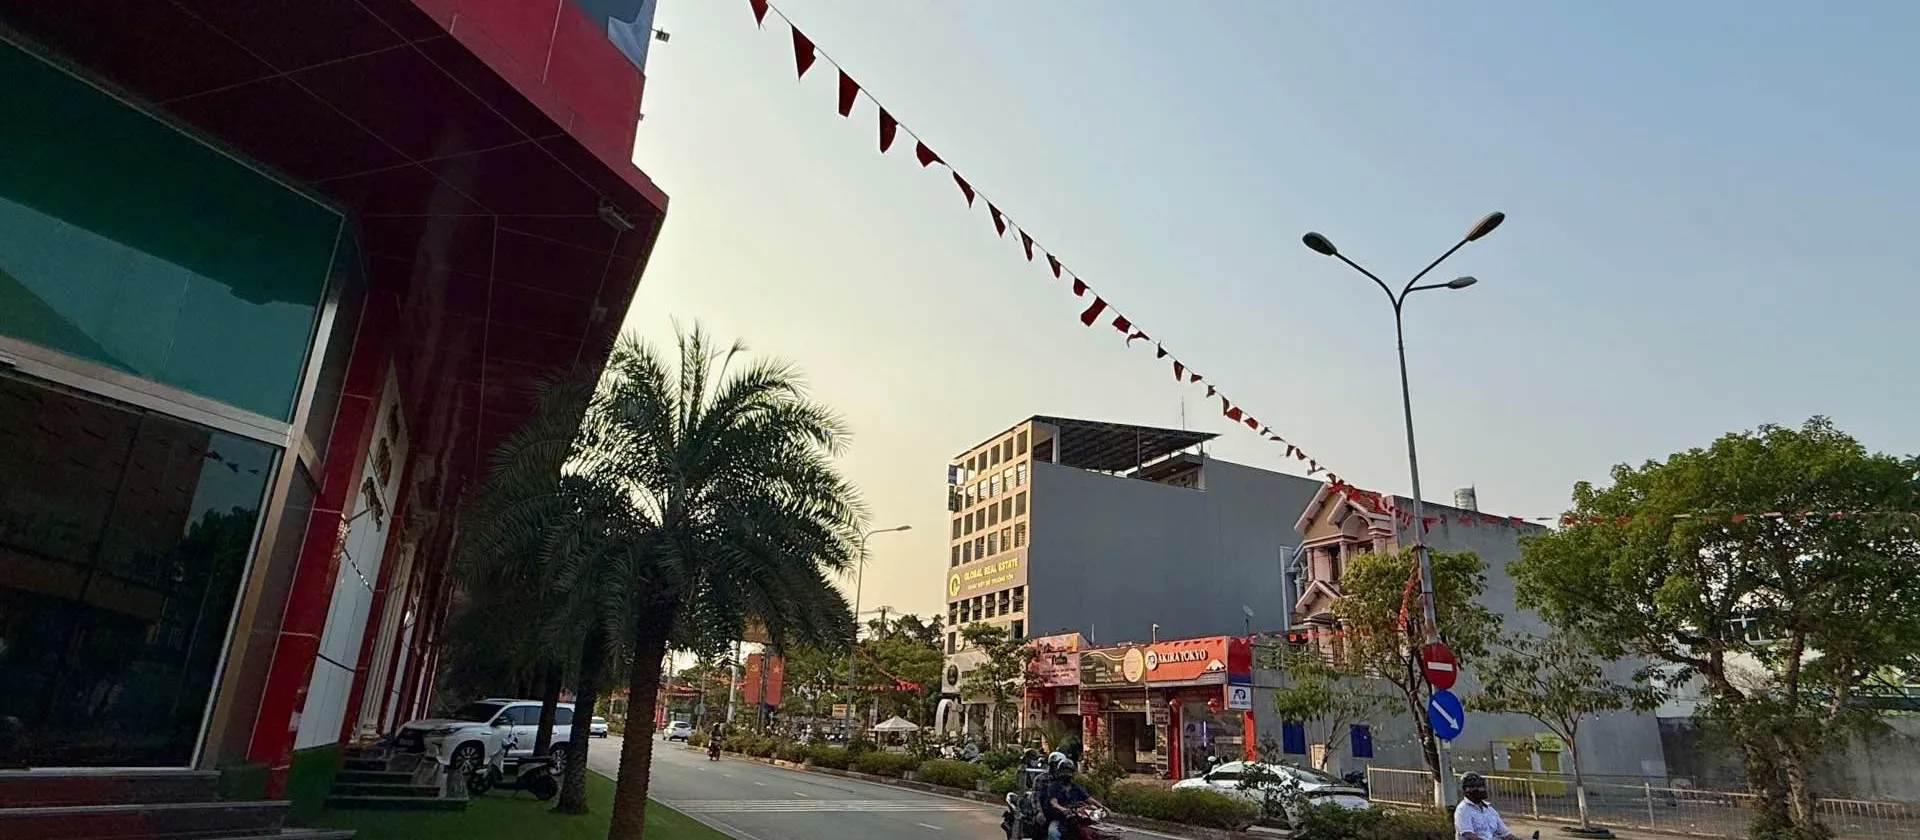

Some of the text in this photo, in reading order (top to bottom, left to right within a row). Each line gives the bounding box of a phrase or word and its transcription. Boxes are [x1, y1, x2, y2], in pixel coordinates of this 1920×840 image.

[964, 558, 1018, 580] GLOBAL REAL ESTATE
[1180, 649, 1206, 662] TOKYO
